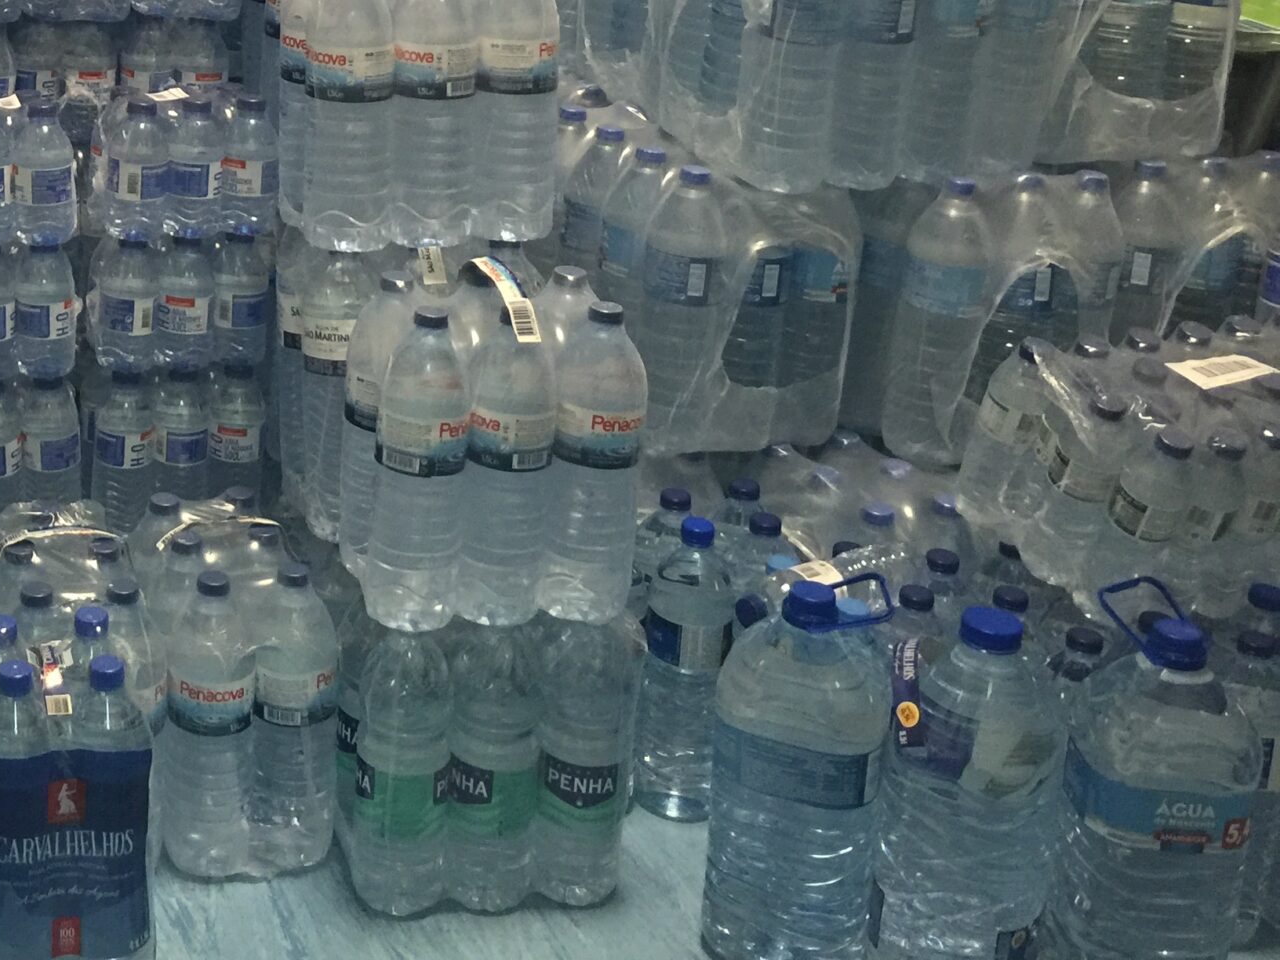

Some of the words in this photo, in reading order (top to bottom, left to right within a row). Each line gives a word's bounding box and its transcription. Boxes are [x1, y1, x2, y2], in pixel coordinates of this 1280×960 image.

[179, 680, 245, 704] Penacova
[547, 767, 615, 795] PENHA
[1155, 797, 1216, 819] ÁGUA
